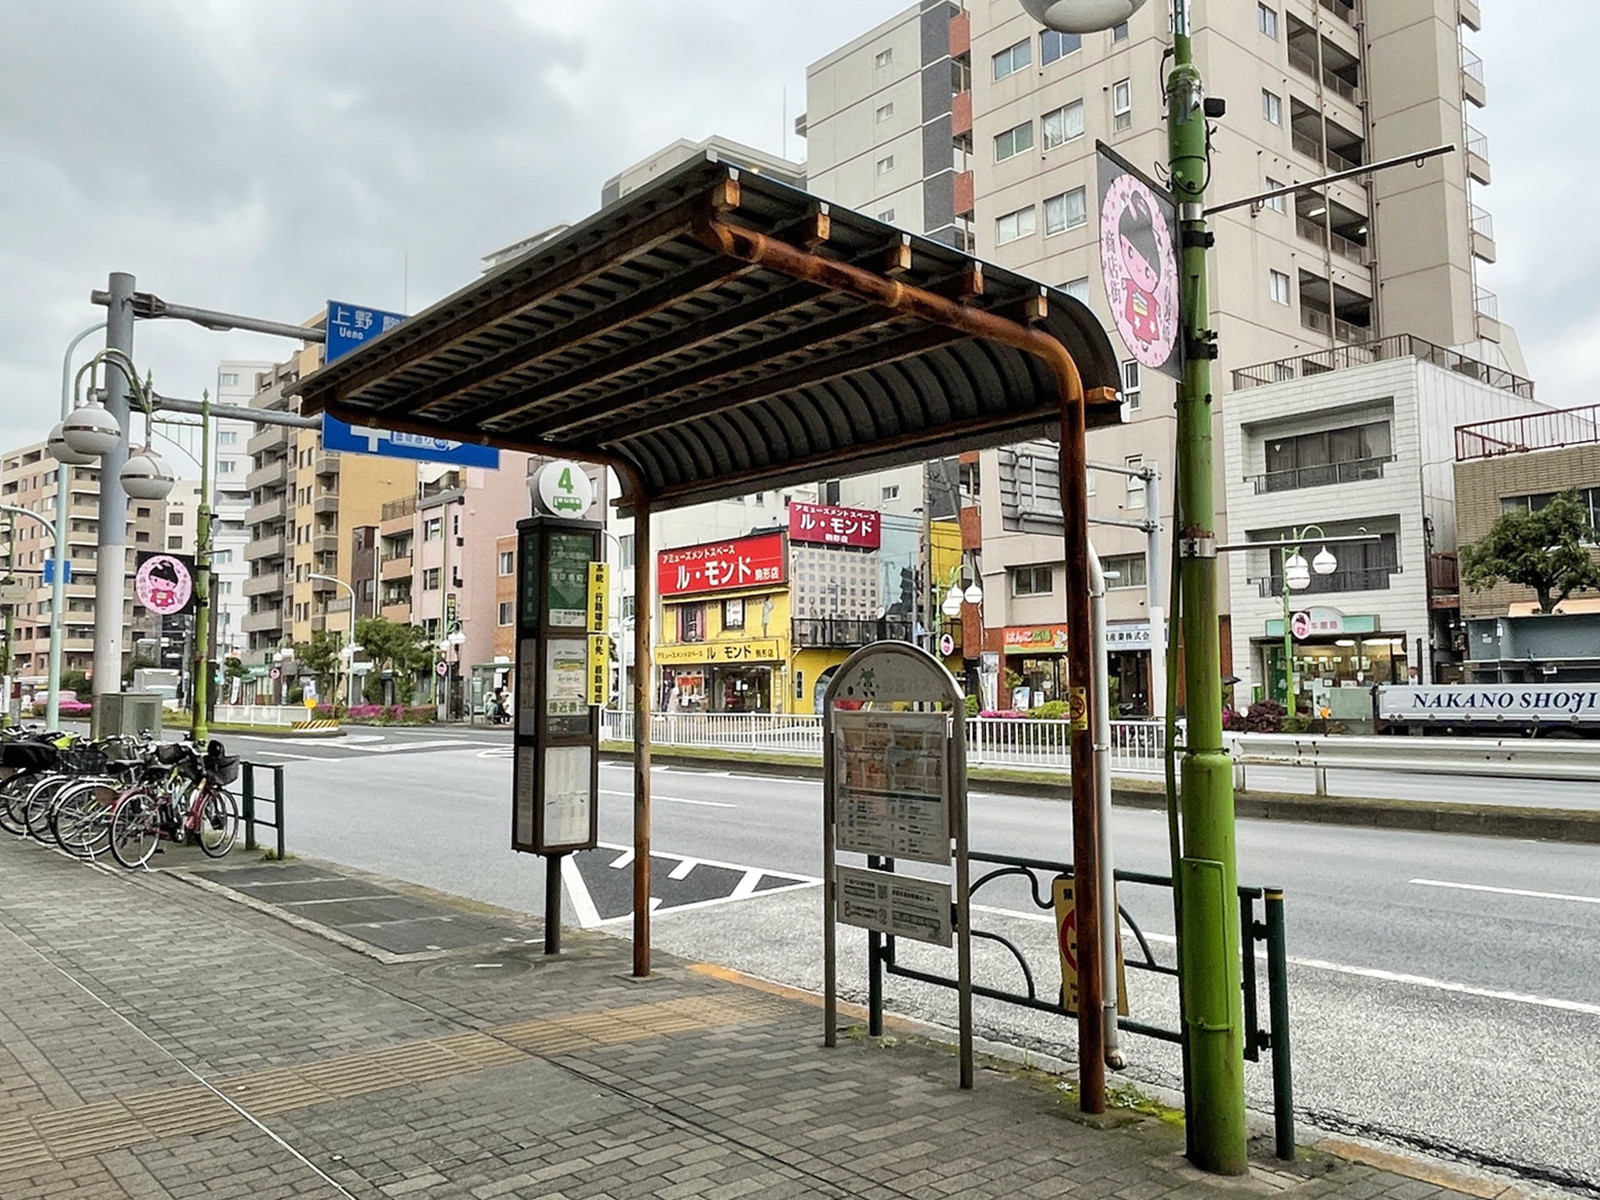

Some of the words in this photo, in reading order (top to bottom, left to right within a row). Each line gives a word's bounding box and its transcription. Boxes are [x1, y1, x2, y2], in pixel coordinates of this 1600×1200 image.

[331, 306, 373, 330] 上野
[339, 327, 364, 340] Ueno
[558, 467, 574, 494] 4
[800, 513, 872, 537] ル・モンド
[662, 545, 736, 564] アミューズメントスペース
[676, 556, 752, 590] ル・モンド
[754, 566, 780, 581] 駒形店
[1411, 693, 1514, 709] NAKANO
[1519, 692, 1597, 714] SHOJI
